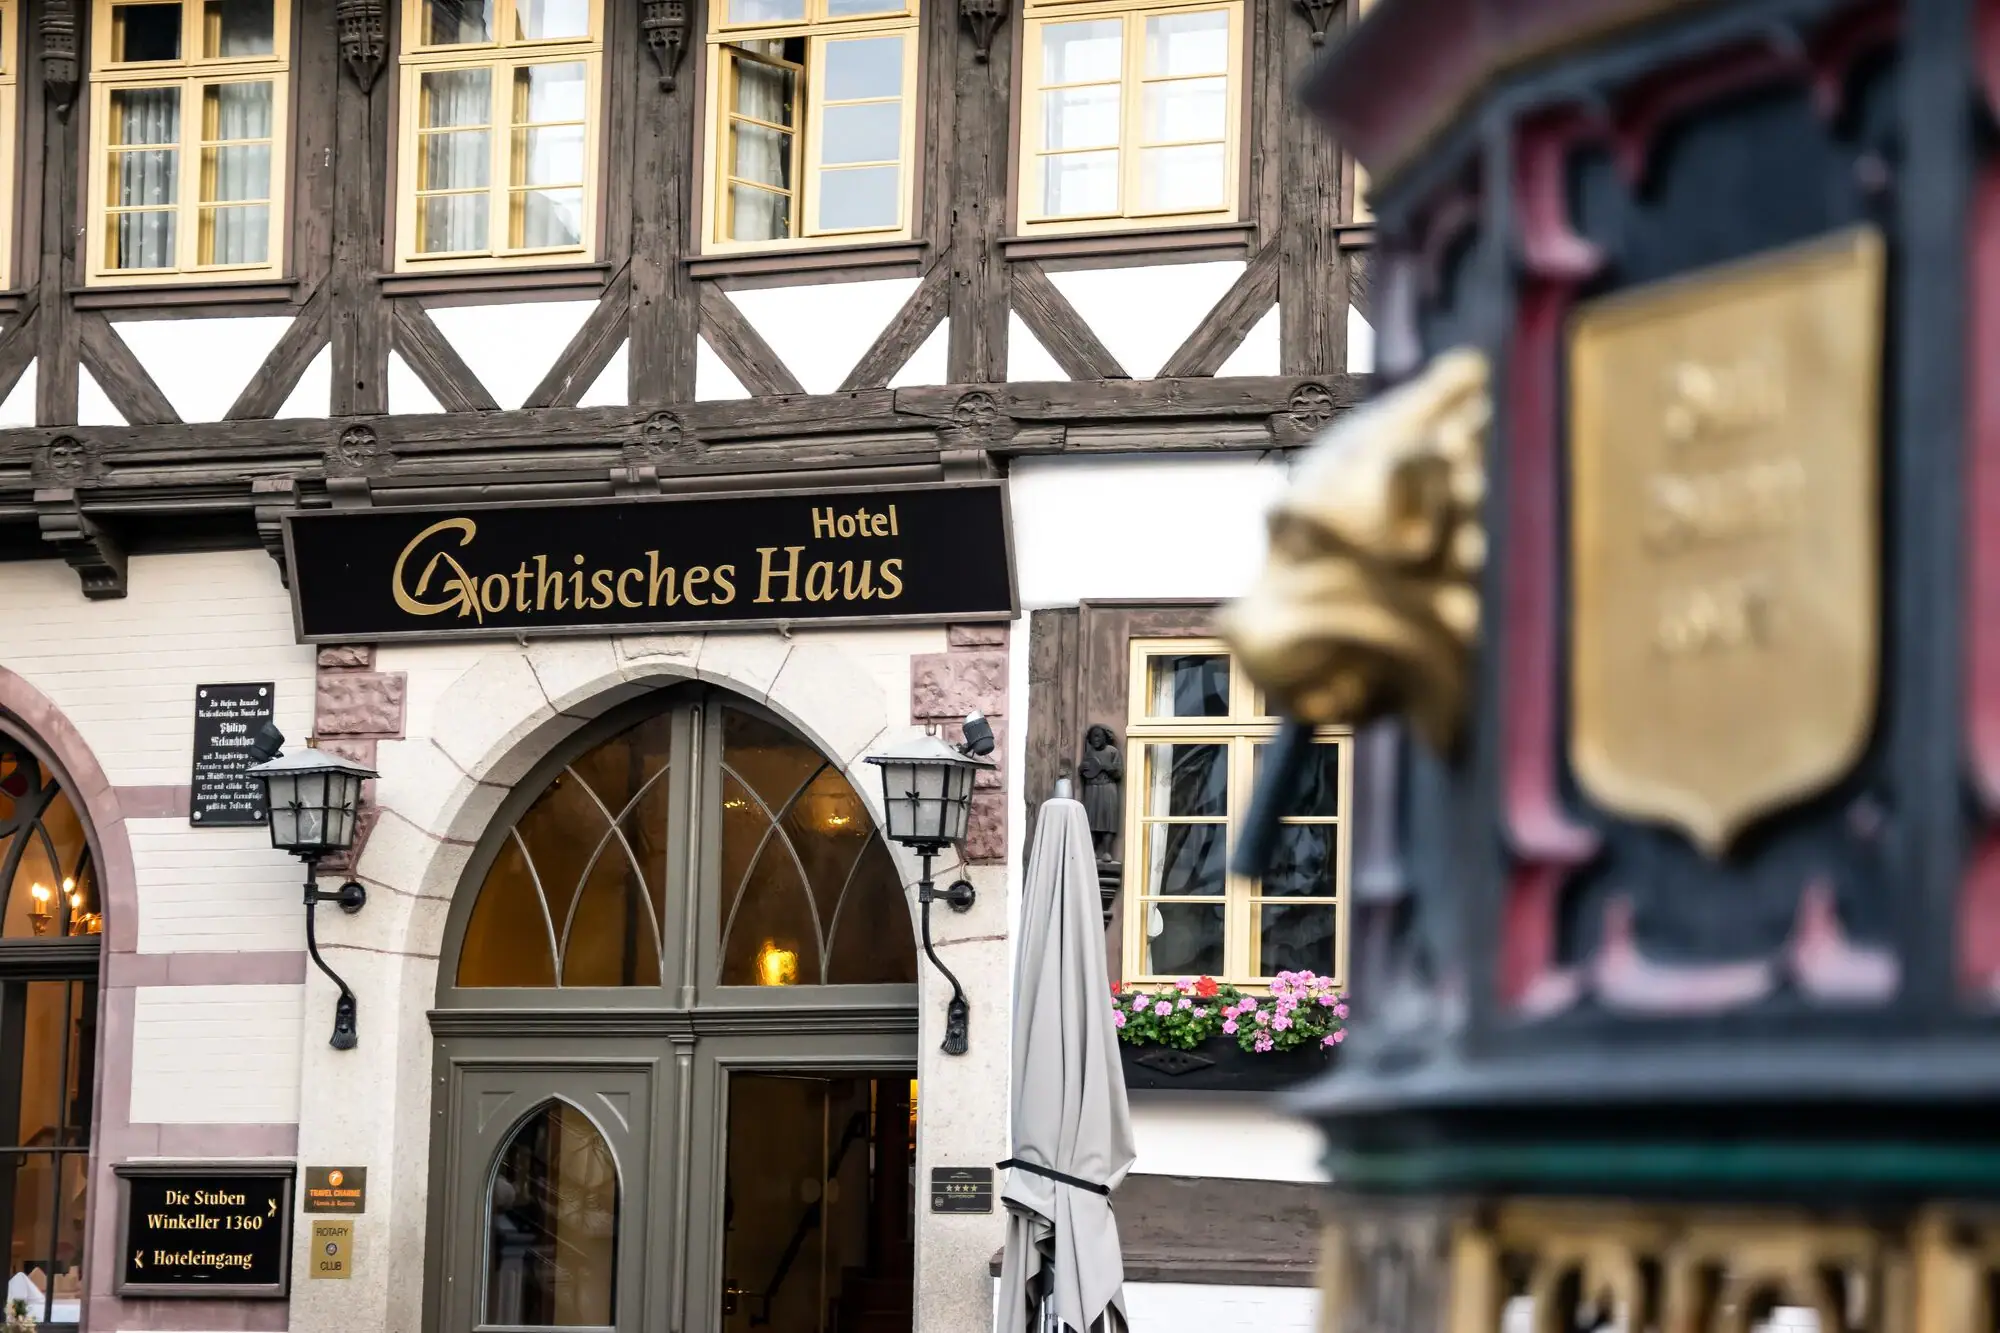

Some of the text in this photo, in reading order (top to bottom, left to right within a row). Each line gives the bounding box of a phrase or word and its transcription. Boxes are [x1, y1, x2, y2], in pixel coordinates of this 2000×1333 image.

[811, 504, 899, 539] Hotel
[392, 517, 904, 625] Gothisches Haus
[220, 723, 247, 734] Philipp
[165, 1190, 246, 1205] Die Stuben
[310, 1189, 333, 1197] TRAVEL
[147, 1214, 263, 1230] Winkeller 1360
[316, 1227, 349, 1237] ROTARY
[153, 1250, 253, 1269] Hoteleingang
[320, 1261, 342, 1271] CLUB
